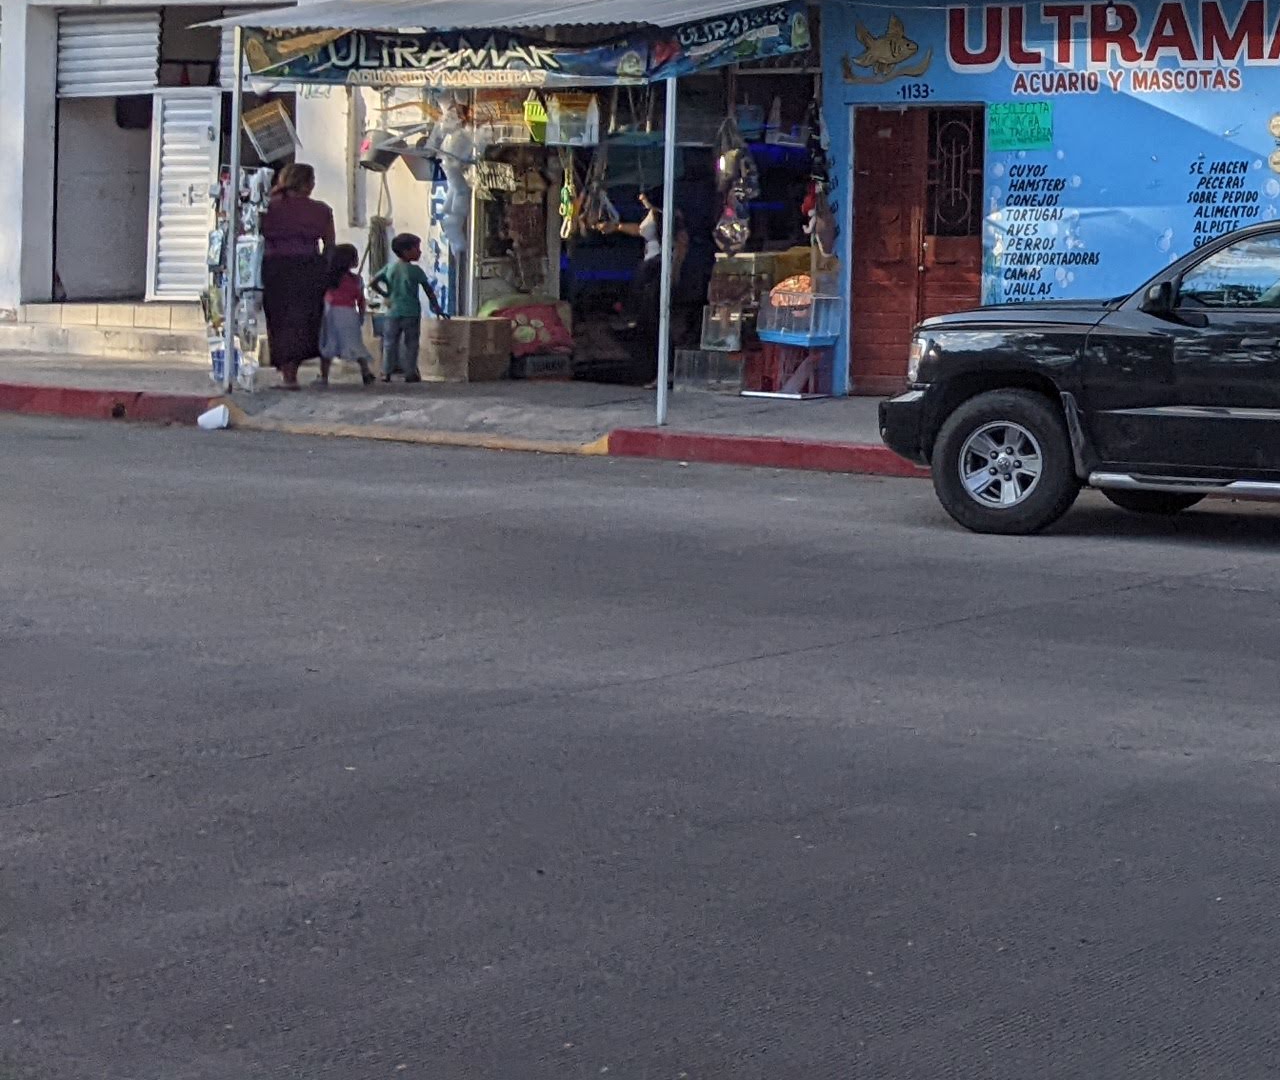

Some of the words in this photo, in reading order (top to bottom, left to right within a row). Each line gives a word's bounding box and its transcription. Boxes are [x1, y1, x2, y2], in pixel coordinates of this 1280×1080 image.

[1012, 71, 1099, 94] ACUARIO
[1108, 70, 1122, 91] Y
[1132, 69, 1241, 92] MASCOTAS
[1009, 165, 1048, 178] CUYOS
[1189, 162, 1205, 175] SE
[1209, 161, 1249, 174] HACEN
[1008, 179, 1066, 192] HAMSTERS
[1197, 176, 1246, 189] PECERAS
[1006, 194, 1060, 207] CONEJOS
[1187, 191, 1217, 203] SOBRE
[1221, 191, 1259, 203] PEDIDO
[1006, 207, 1064, 221] TORTUGAS
[1193, 205, 1260, 218] ALIMENTOS
[1007, 223, 1039, 236] AVES
[1193, 220, 1240, 233] ALPISTE
[1006, 237, 1056, 251] PERROS
[1003, 252, 1100, 266] TRANSPORTADORAS
[1003, 268, 1042, 281] CAMAS
[1003, 282, 1053, 296] JAULAS
